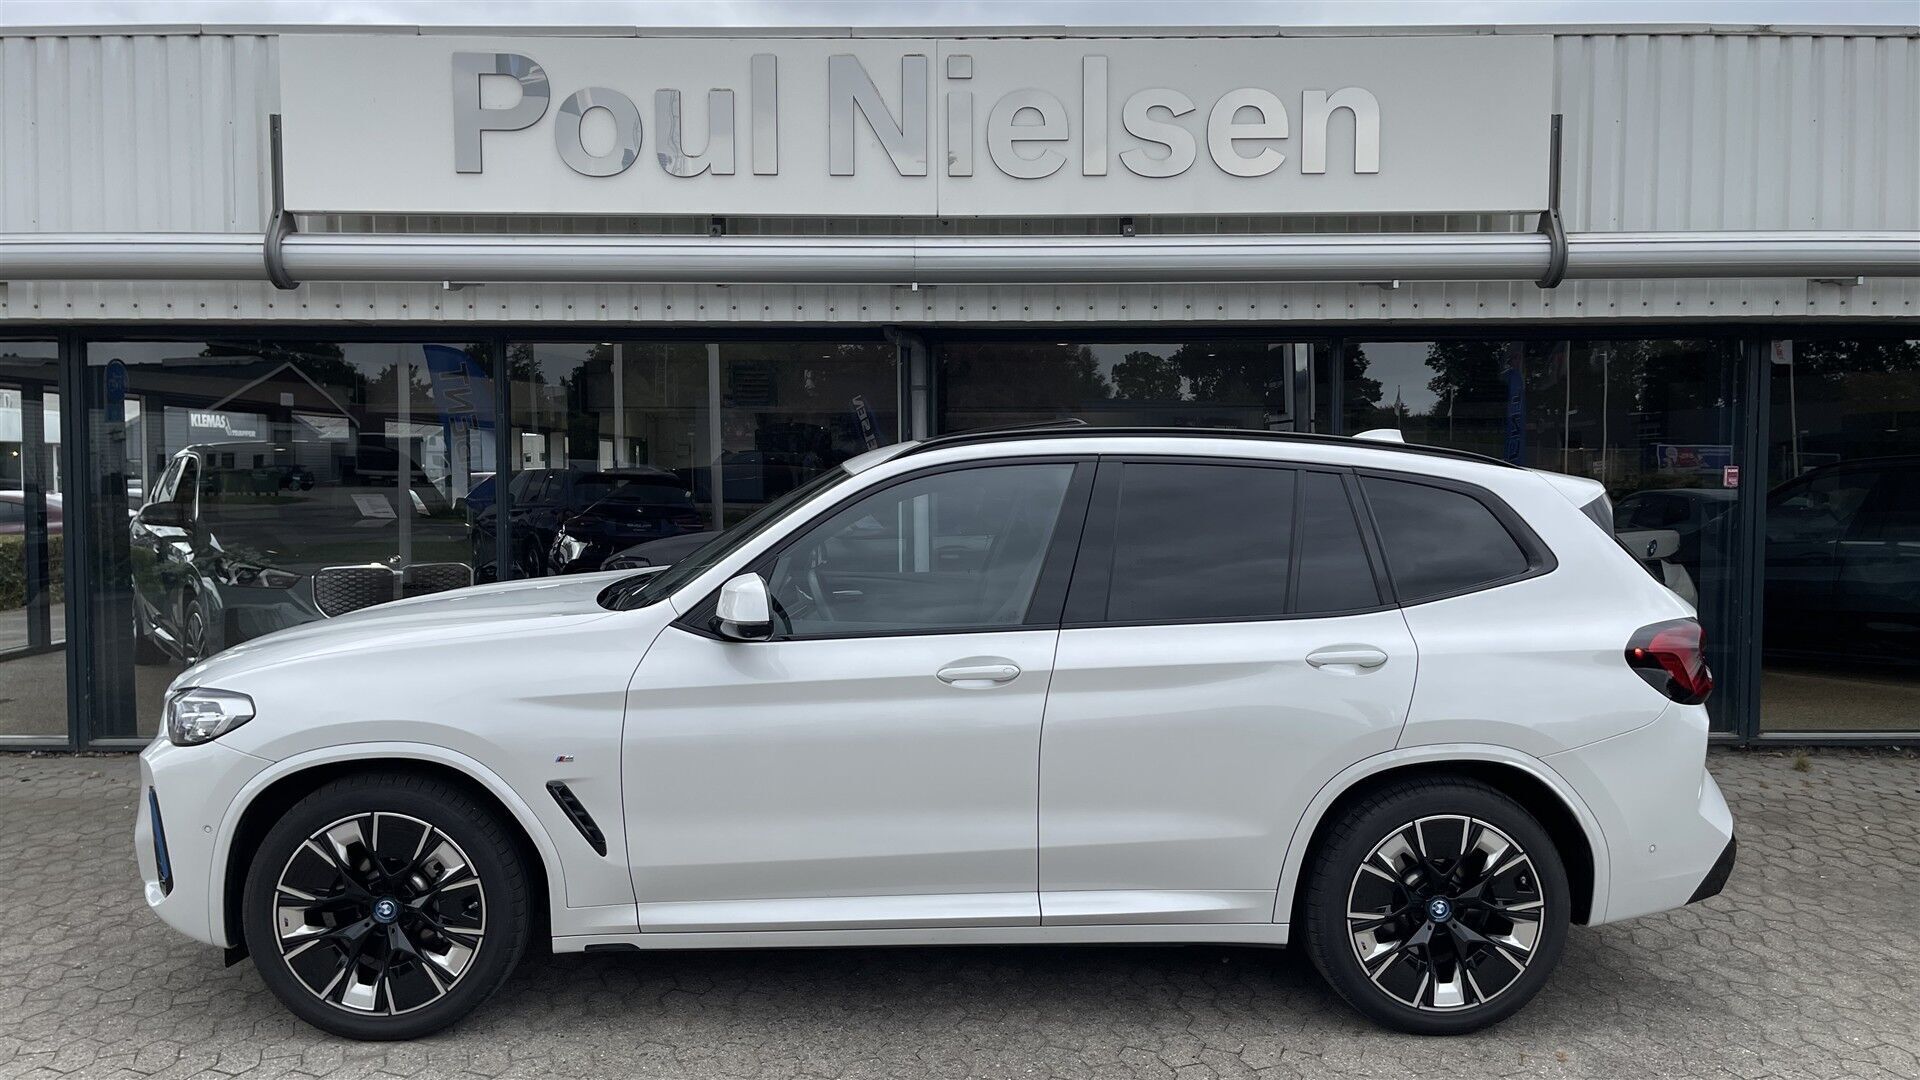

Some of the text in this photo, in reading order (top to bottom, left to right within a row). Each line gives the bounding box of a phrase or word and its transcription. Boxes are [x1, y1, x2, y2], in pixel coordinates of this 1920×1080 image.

[452, 51, 1381, 180] Poul Nielsen
[190, 412, 226, 428] KLEMAS
